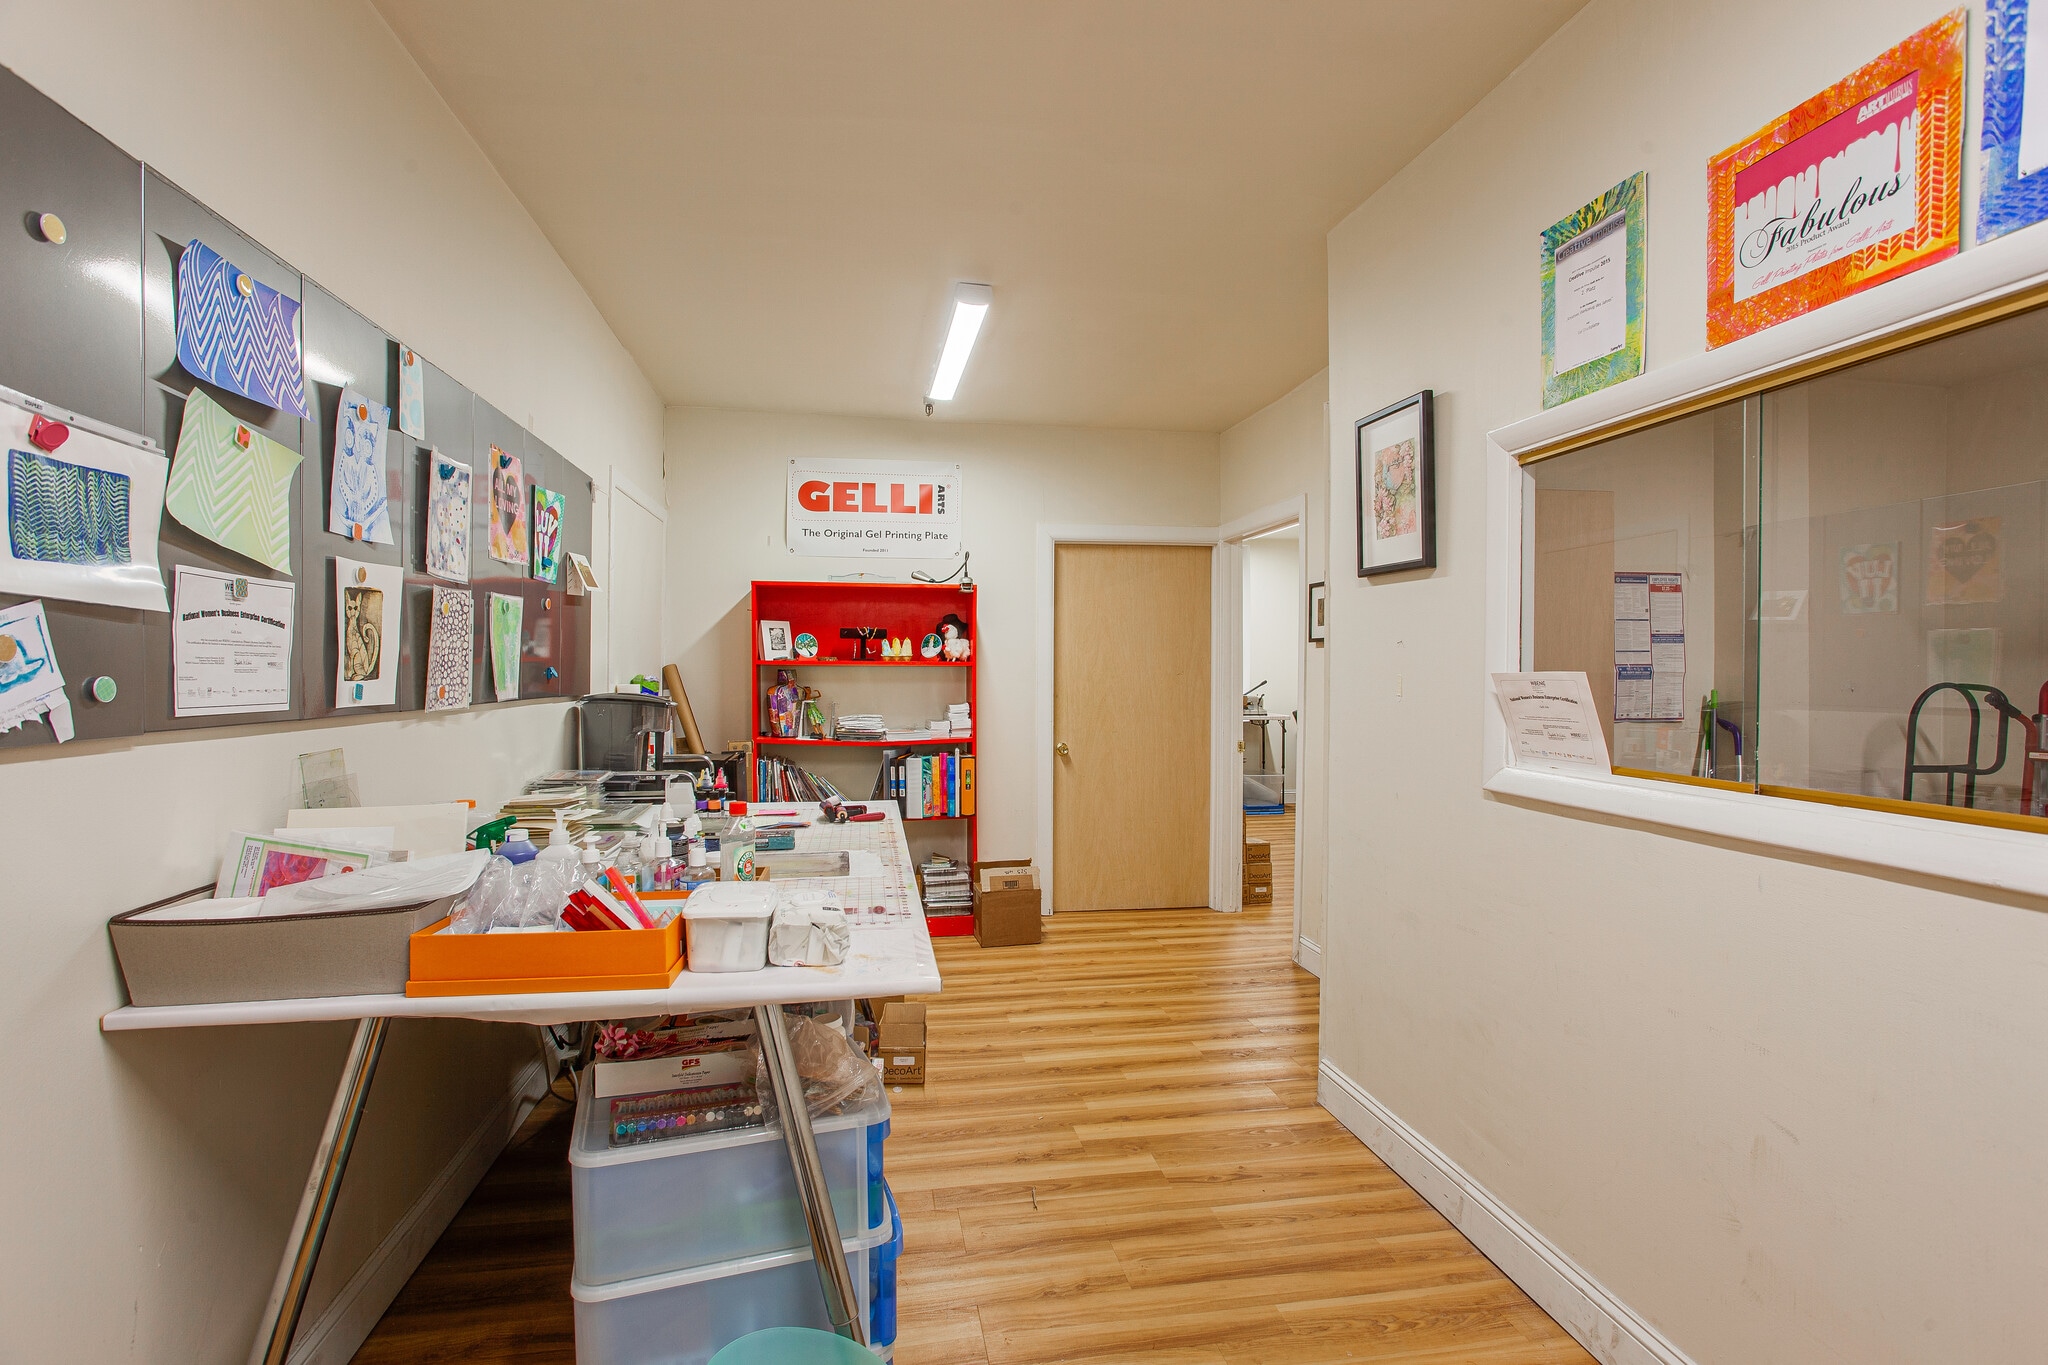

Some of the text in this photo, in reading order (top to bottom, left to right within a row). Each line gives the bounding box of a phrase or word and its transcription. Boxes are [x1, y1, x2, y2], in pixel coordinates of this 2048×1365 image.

[1739, 172, 1911, 268] Fabulous
[1800, 231, 1826, 247] Product
[1827, 218, 1850, 234] Award
[1557, 216, 1625, 261] Creative Impulse
[494, 477, 517, 498] ALL MY
[797, 480, 933, 515] GELLI
[937, 484, 945, 515] ARTS
[495, 495, 519, 515] LOVING
[537, 509, 558, 538] LUV
[801, 528, 949, 542] The Original Gel Printing Plate
[182, 609, 286, 630] National Women's Business Enterprise Certification
[682, 1058, 700, 1066] GFS
